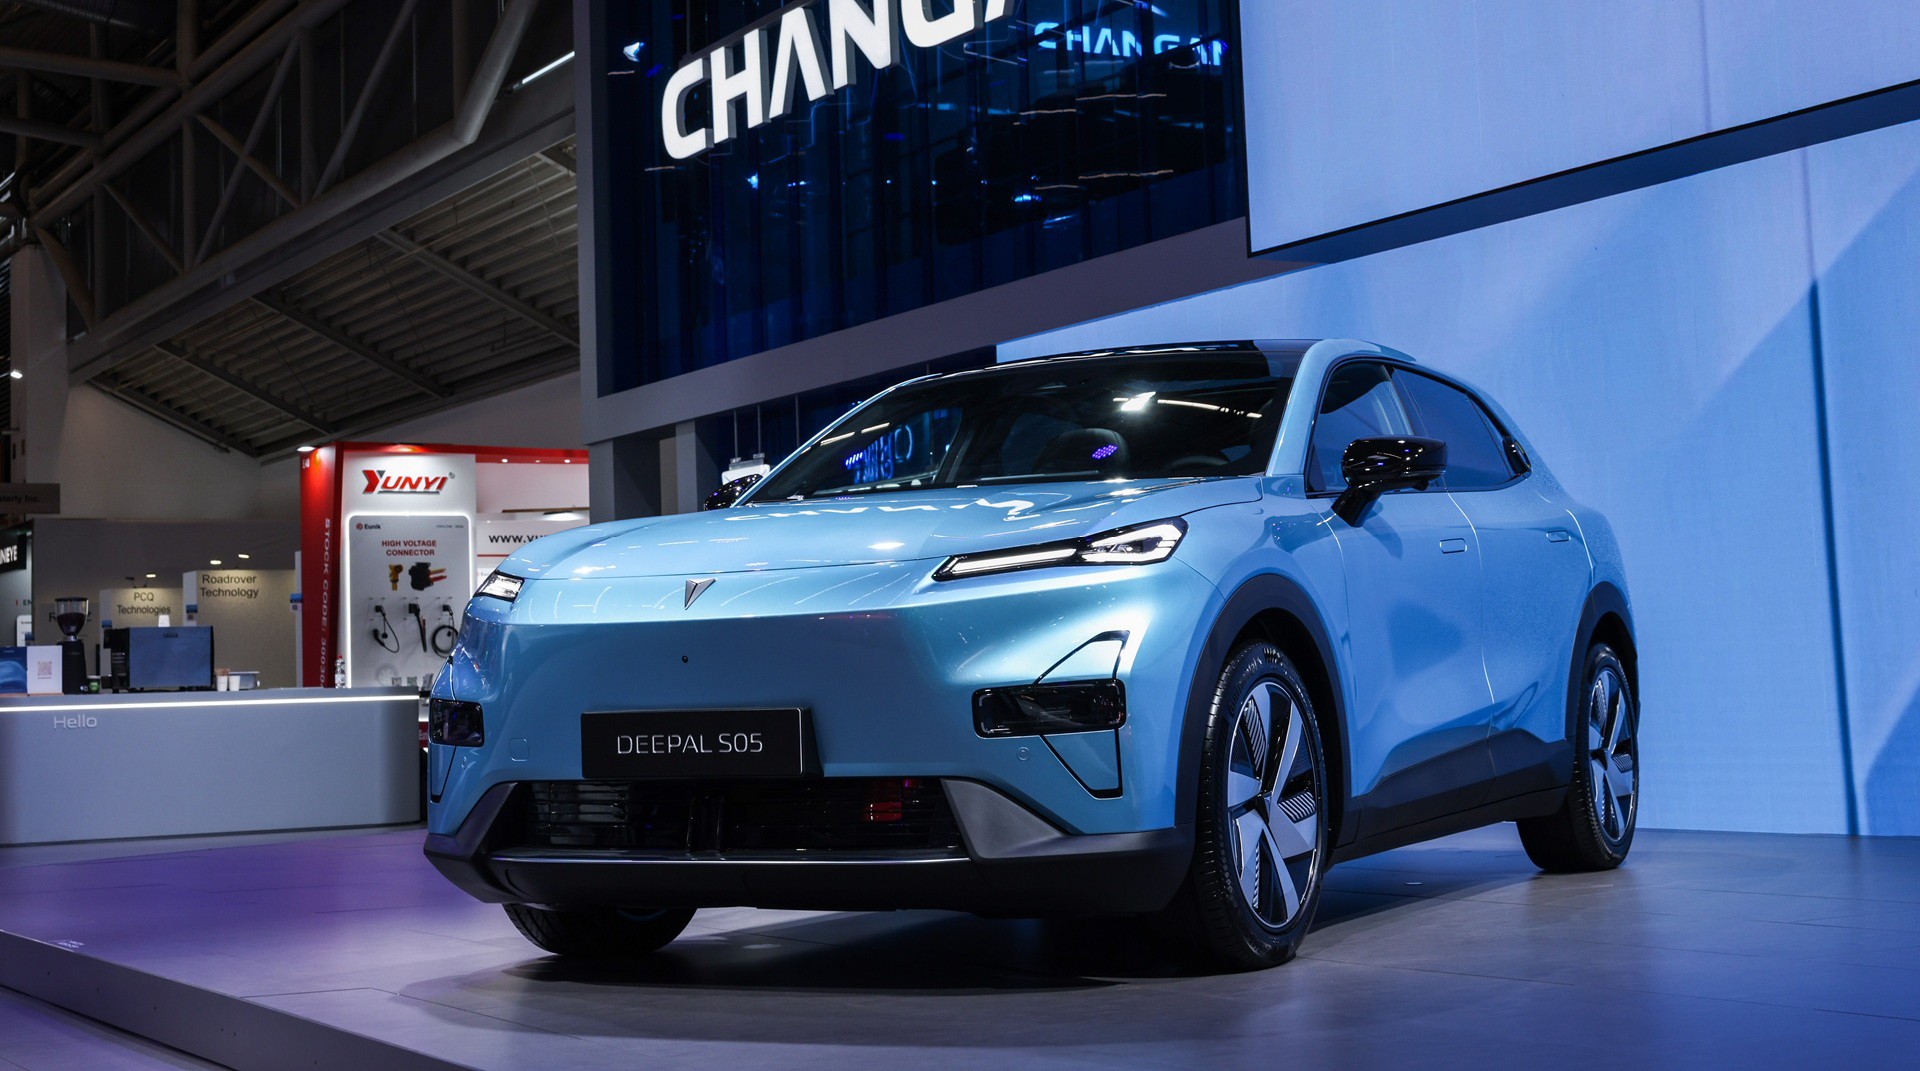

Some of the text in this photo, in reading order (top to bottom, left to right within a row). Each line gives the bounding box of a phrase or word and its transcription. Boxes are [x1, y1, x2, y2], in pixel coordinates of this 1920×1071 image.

[661, 0, 1006, 160] CHAN
[362, 469, 449, 494] YUNYI
[386, 549, 435, 557] CONNECTOR
[202, 574, 257, 584] Roadrover
[133, 592, 155, 602] PCQ
[200, 587, 259, 599] Technology
[117, 605, 171, 615] Technologies
[319, 636, 328, 689] 30030
[53, 714, 97, 729] Hello
[617, 734, 713, 754] DEEPAL
